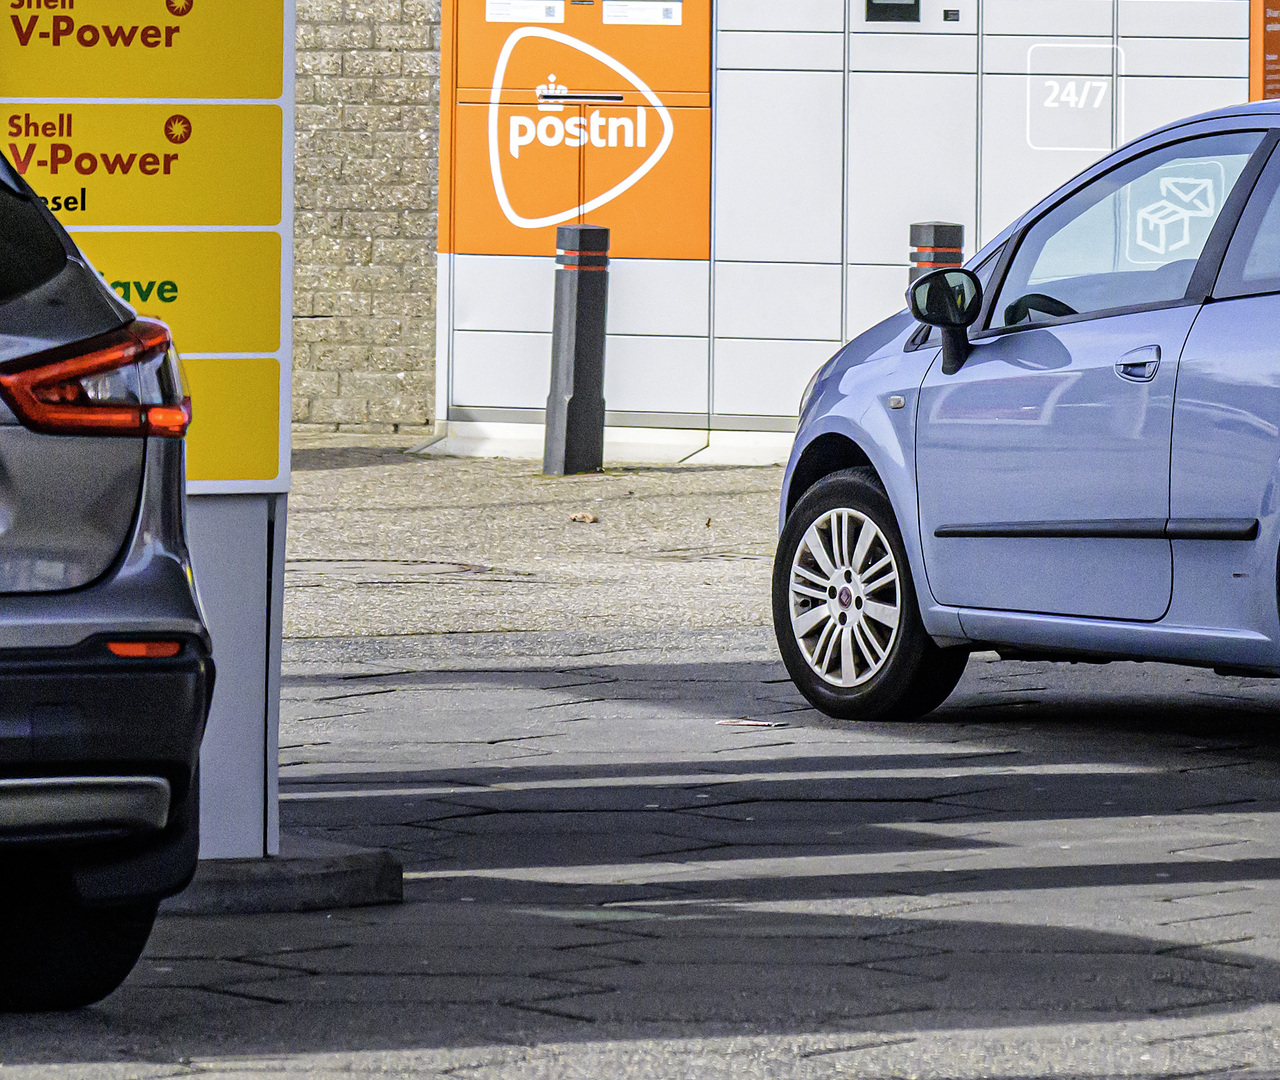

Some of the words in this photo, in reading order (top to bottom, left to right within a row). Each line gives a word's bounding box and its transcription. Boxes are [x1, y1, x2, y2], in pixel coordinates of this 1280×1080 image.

[10, 14, 180, 48] V-Power
[1043, 80, 1109, 109] 24/7
[8, 113, 73, 138] Shell
[509, 105, 647, 160] postnl
[8, 143, 179, 175] V-Power
